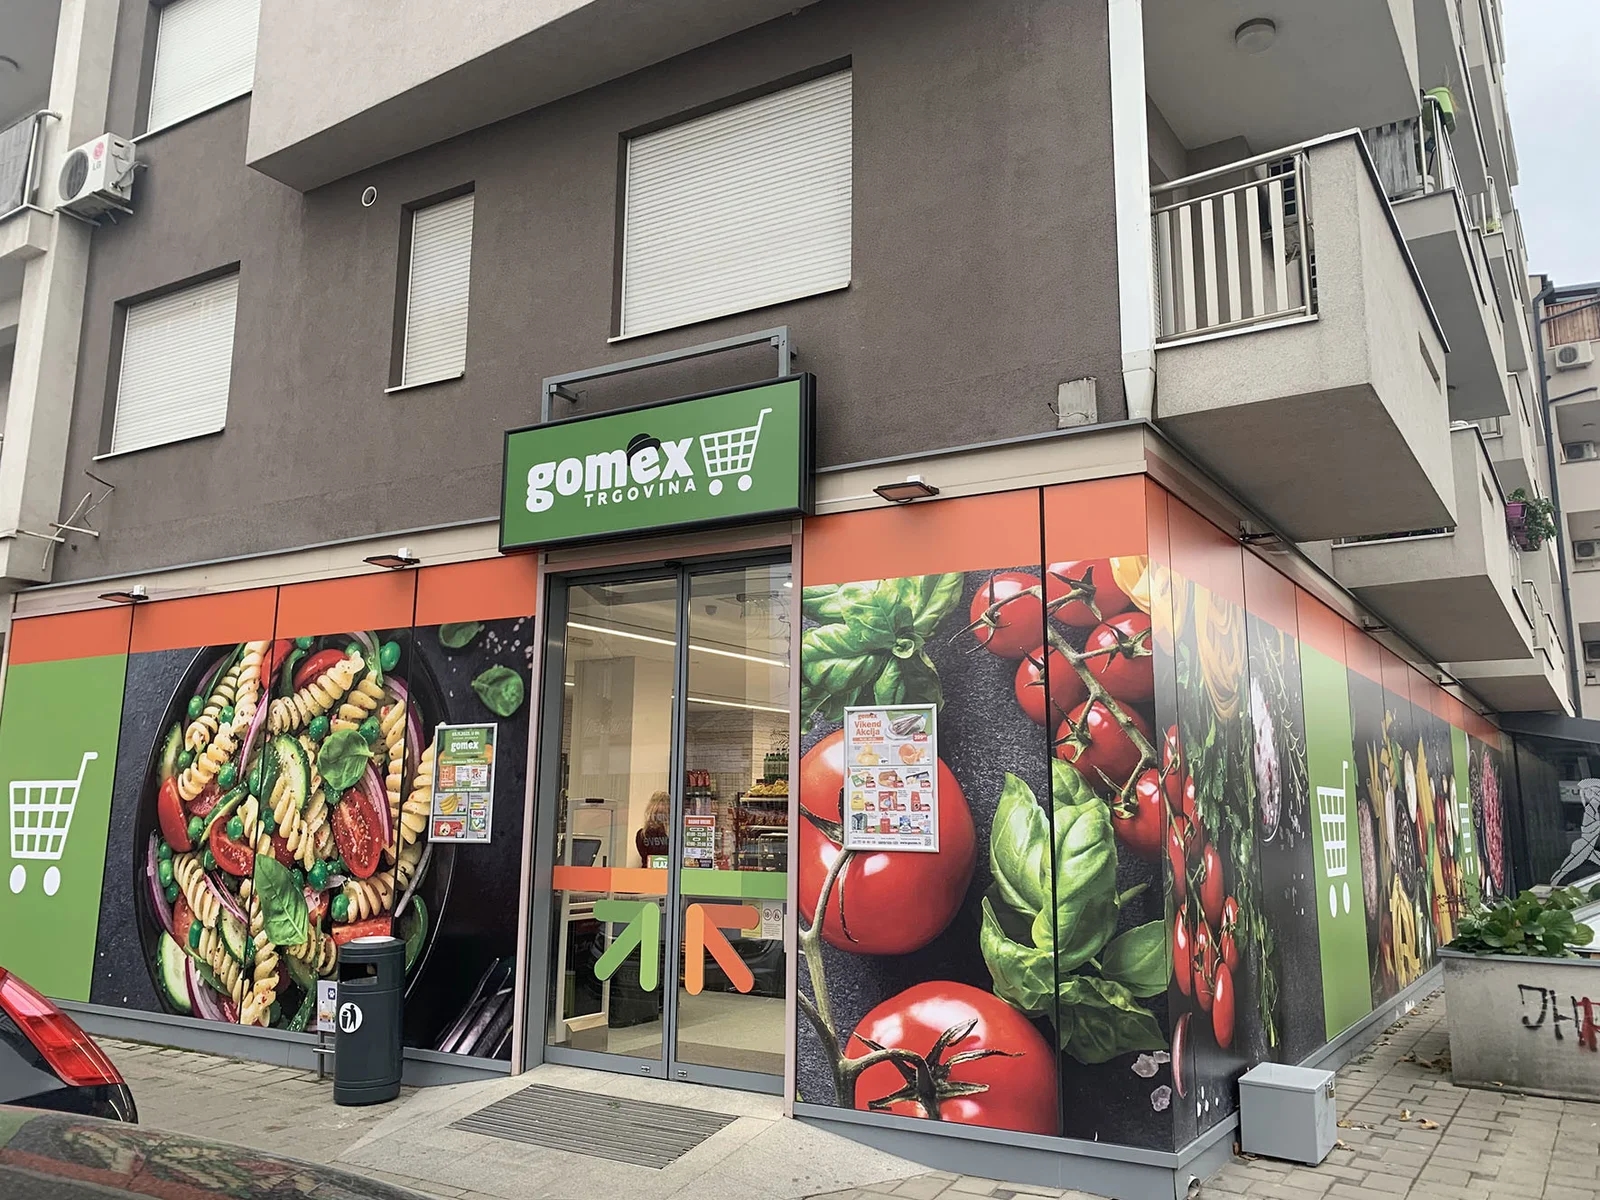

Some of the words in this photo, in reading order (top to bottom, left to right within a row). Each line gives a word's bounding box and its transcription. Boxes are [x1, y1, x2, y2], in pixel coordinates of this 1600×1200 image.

[526, 437, 694, 513] gomex
[584, 477, 697, 508] TRGOVINA
[854, 720, 882, 728] Vikend
[856, 728, 880, 736] Akcija
[451, 741, 479, 753] gomex
